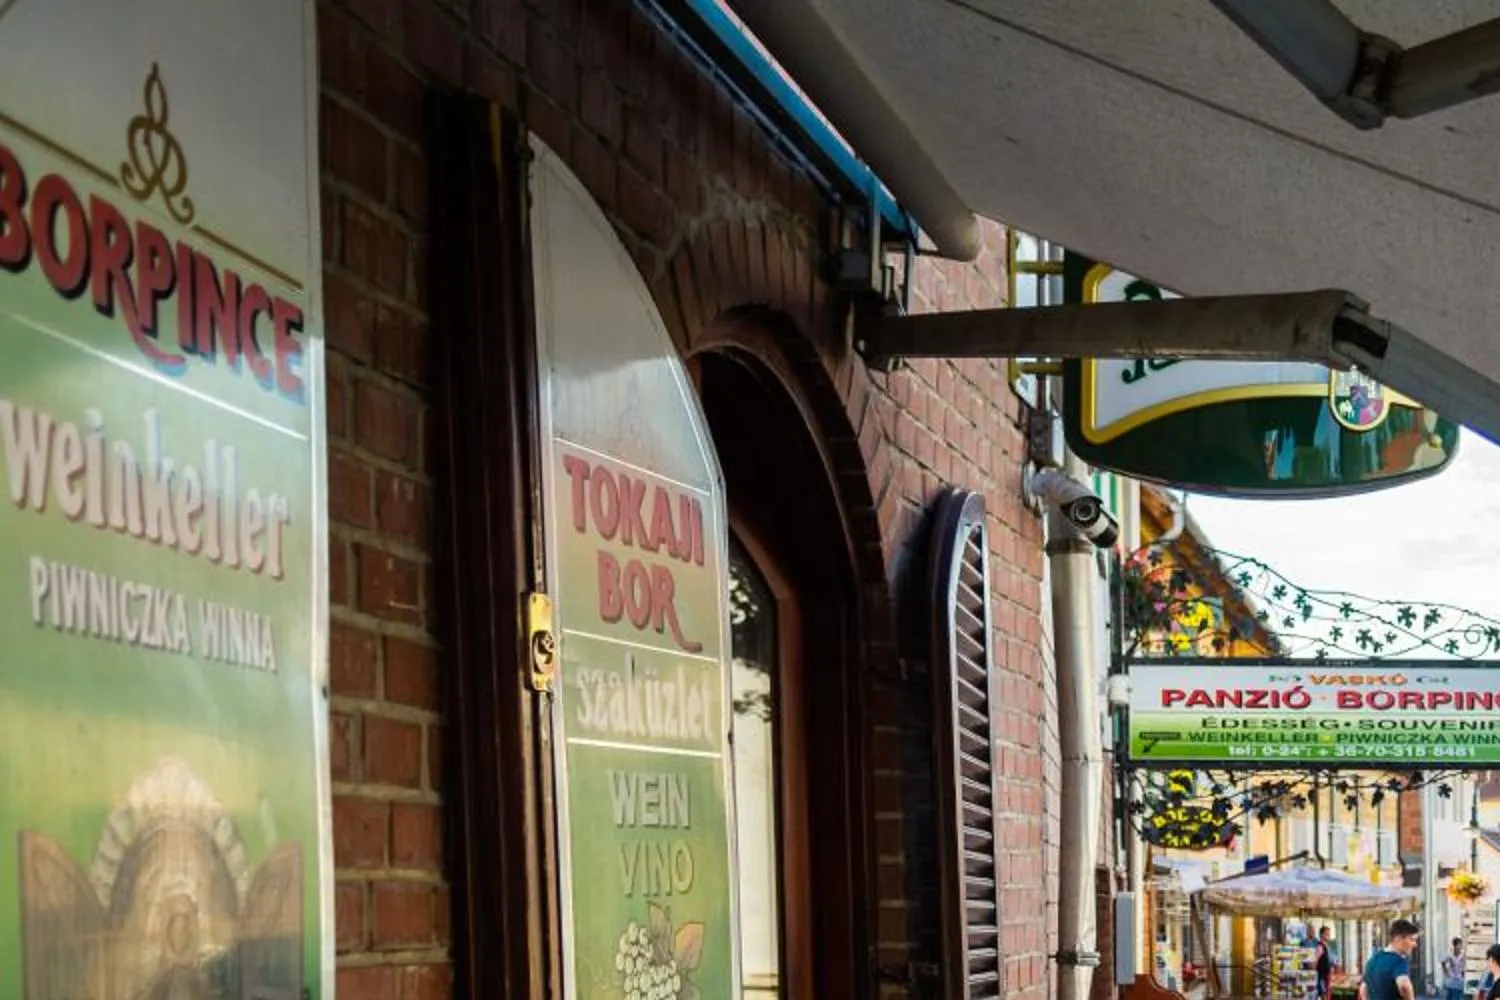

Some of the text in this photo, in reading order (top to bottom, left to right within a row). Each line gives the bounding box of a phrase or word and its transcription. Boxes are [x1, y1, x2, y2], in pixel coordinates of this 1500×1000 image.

[0, 143, 307, 405] BORPINCE
[563, 454, 705, 567] TOKAJI
[28, 555, 278, 674] PIWNICZKA WINNA
[597, 548, 702, 653] BOR
[1161, 685, 1312, 711] PANZIÓ
[1202, 716, 1340, 731] ÉDESSÉG
[1188, 732, 1321, 745] WEINKELLER
[1336, 733, 1448, 745] PIWNICZKA
[609, 769, 691, 829] WEIN
[619, 840, 694, 898] VINO
